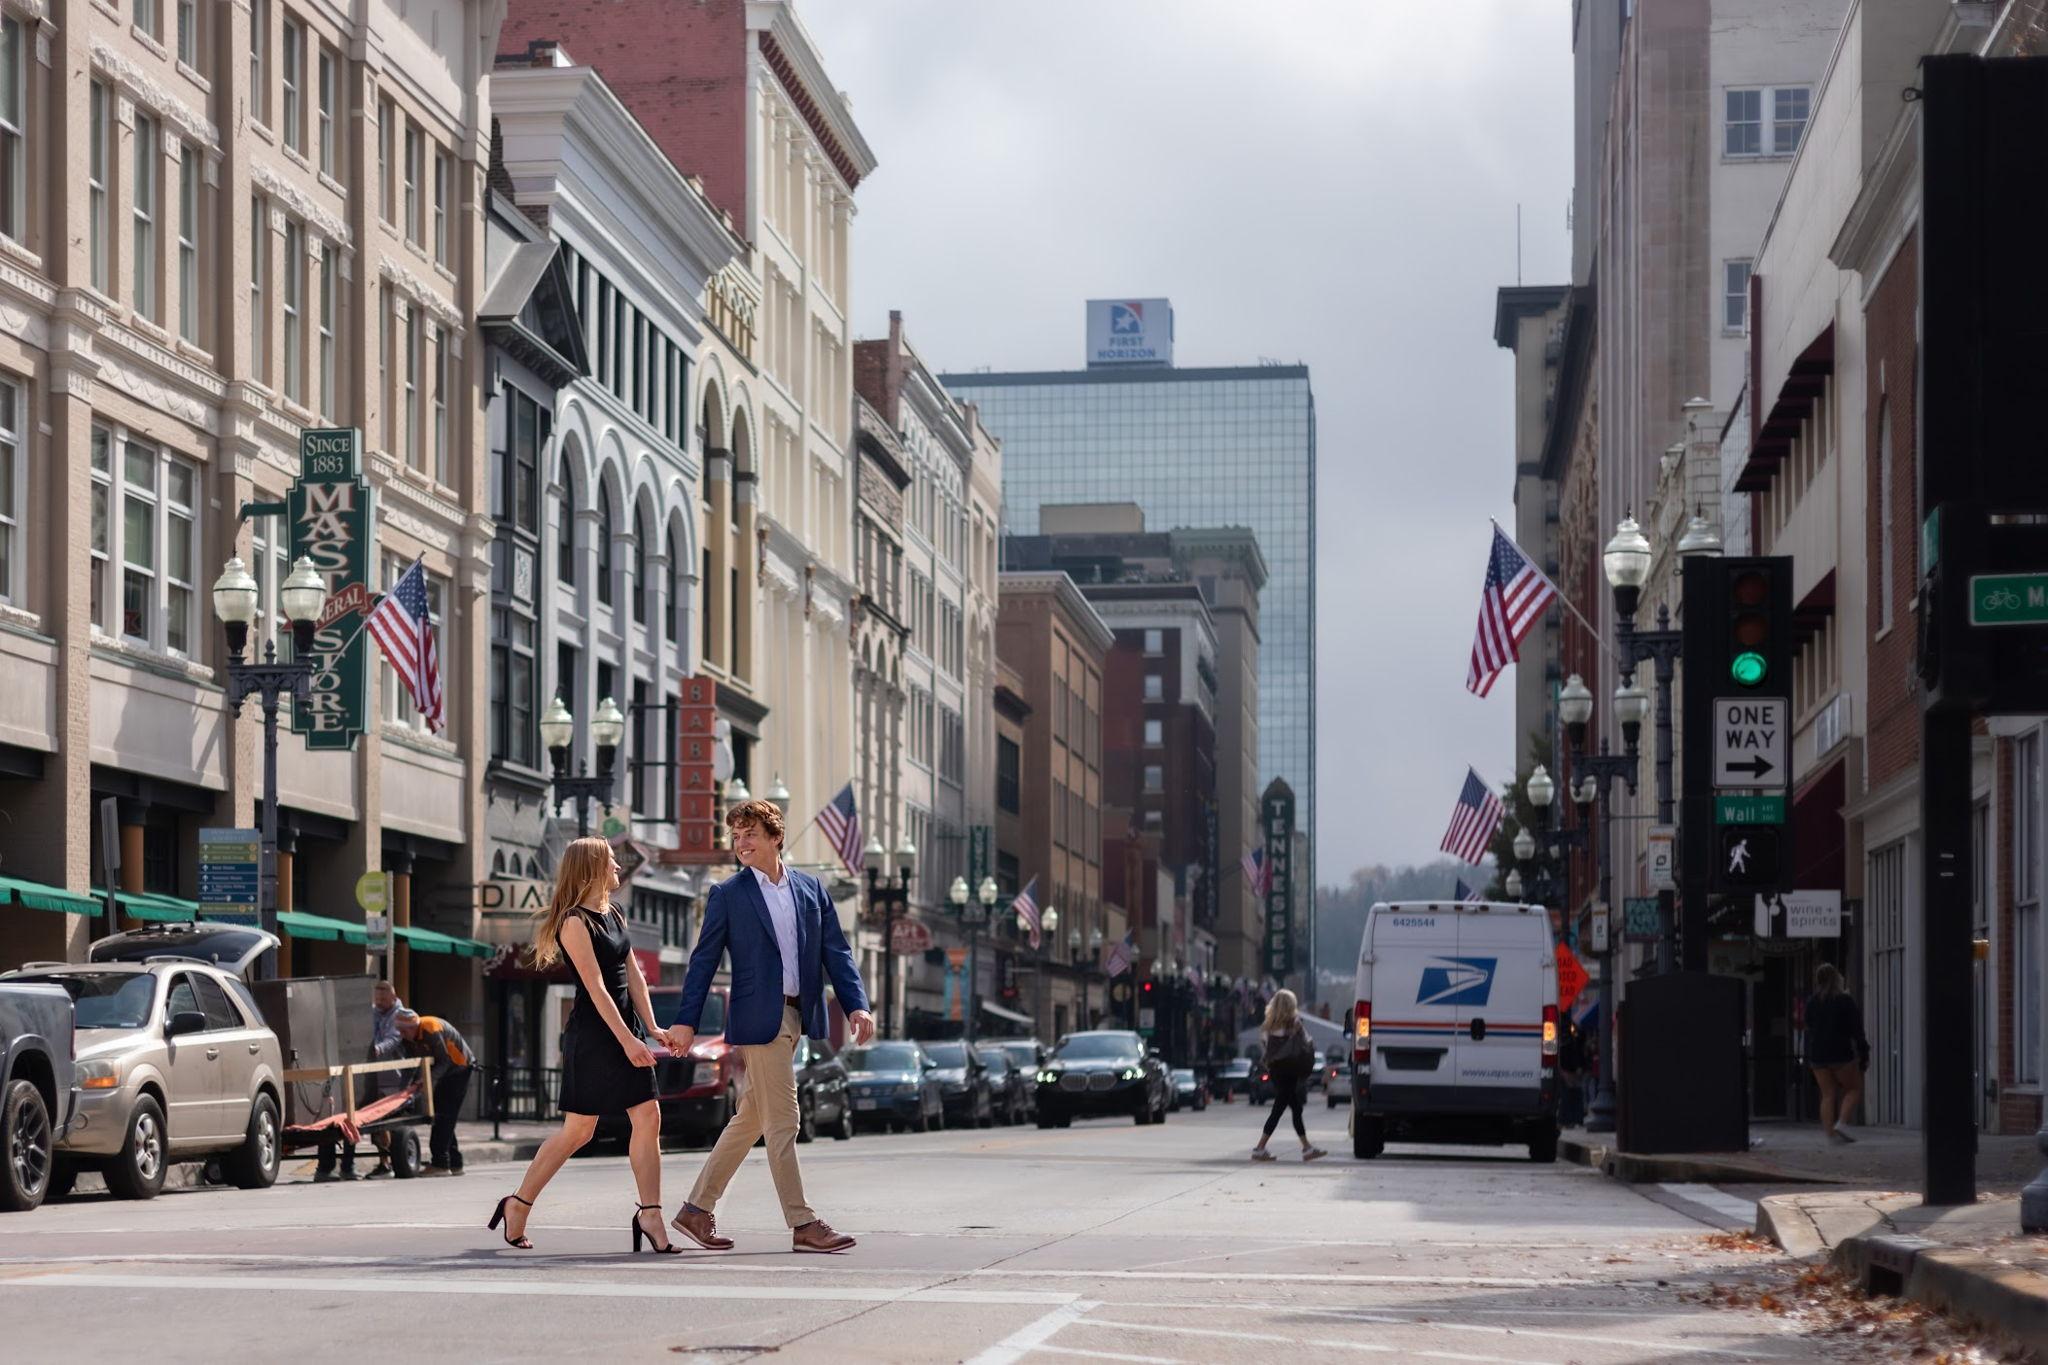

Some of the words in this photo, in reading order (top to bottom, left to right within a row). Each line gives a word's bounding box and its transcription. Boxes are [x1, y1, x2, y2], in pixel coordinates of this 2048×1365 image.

[1109, 337, 1144, 347] FIRST
[1098, 349, 1155, 359] HORIZON
[305, 435, 350, 456] SINCE
[312, 456, 344, 474] 1883
[297, 482, 356, 599] MAST
[310, 628, 347, 732] STORE
[1727, 706, 1775, 725] ONE
[1726, 730, 1776, 749] WAY
[1724, 807, 1755, 821] Wall
[1271, 801, 1286, 970] TENNESSEE
[1790, 904, 1823, 915] wine
[1790, 916, 1838, 928] spirits
[1462, 1068, 1535, 1081] www.usps.com
